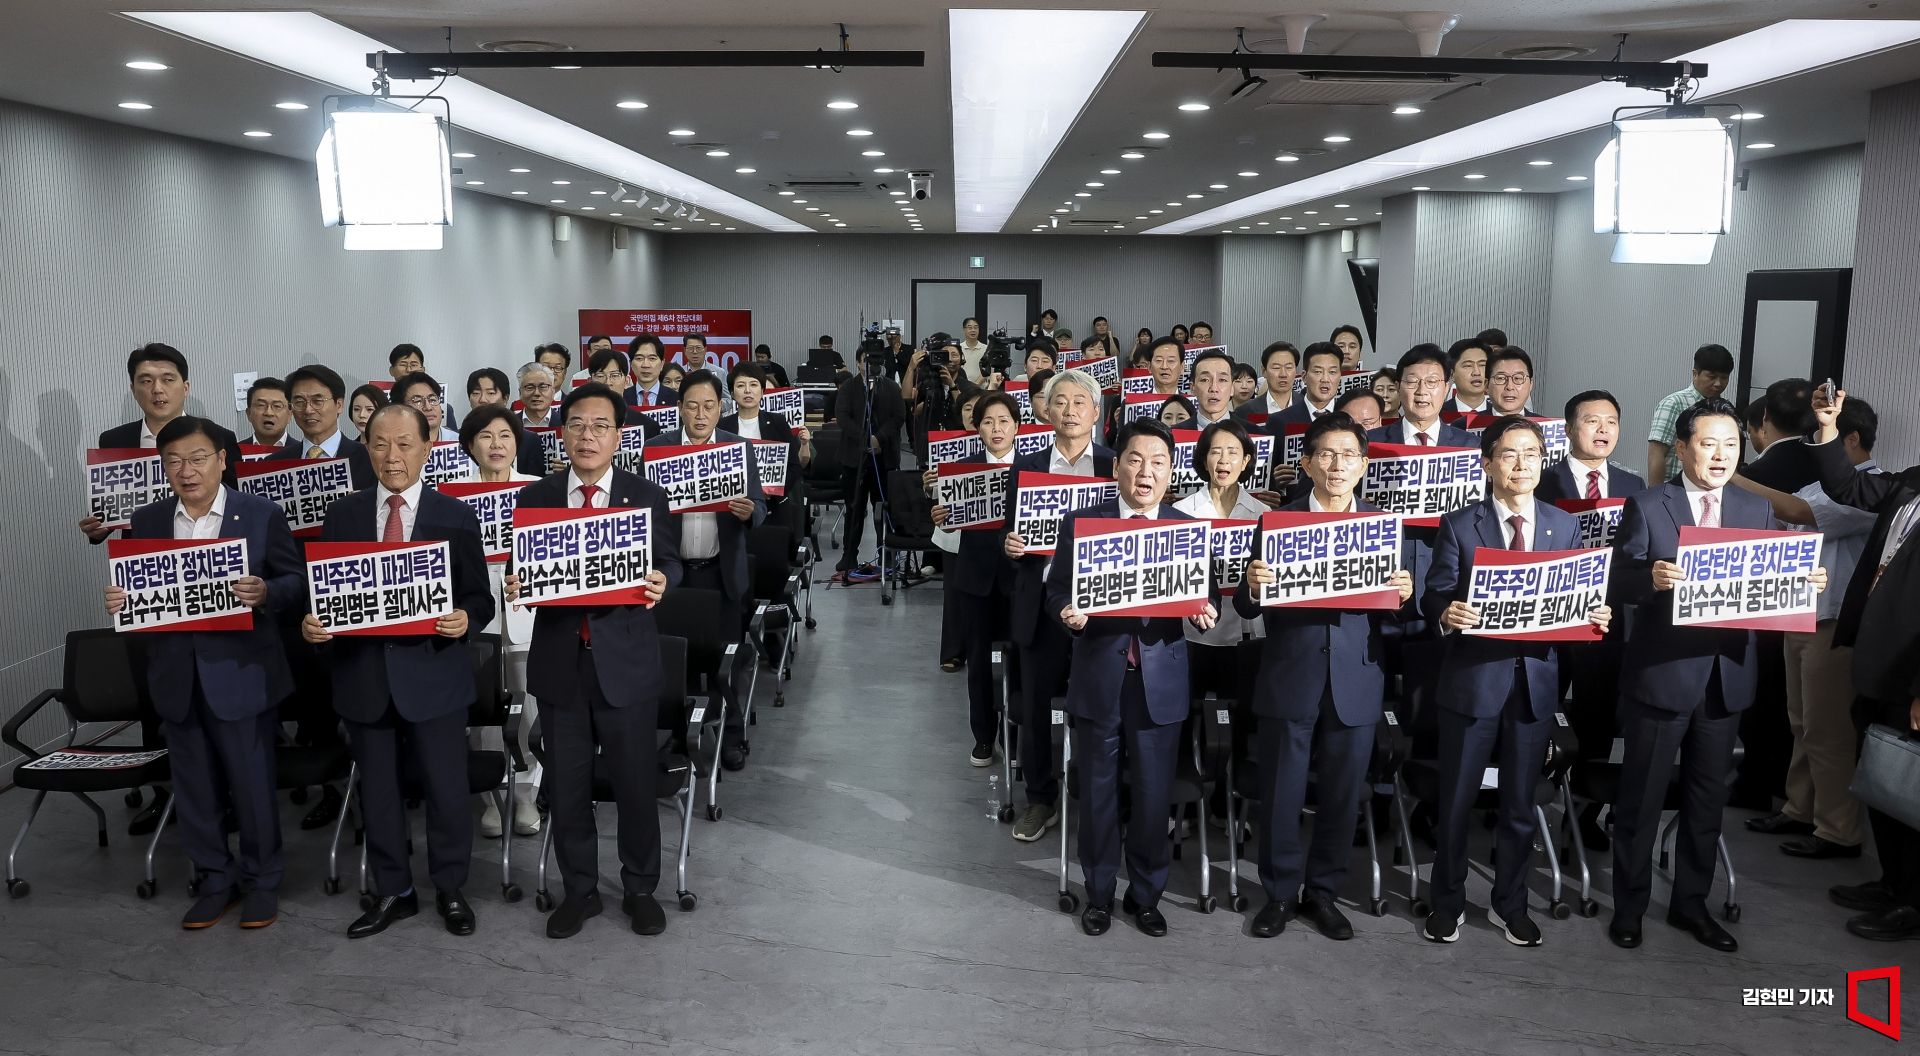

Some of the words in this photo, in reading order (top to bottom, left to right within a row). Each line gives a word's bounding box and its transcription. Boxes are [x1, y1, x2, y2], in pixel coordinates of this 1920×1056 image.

[657, 314, 675, 322] 제6차
[676, 314, 703, 322] 전당대회
[769, 391, 802, 413] 파괴특검
[91, 461, 148, 495] 민주주의
[296, 462, 348, 496] 정치보복
[697, 446, 744, 477] 정치보복
[1366, 458, 1423, 490] 민주주의
[1426, 453, 1484, 485] 파괴특검
[699, 471, 745, 502] 중단하라
[1020, 487, 1074, 518] 민주주의
[517, 522, 581, 563] 야당탄압
[584, 512, 648, 554] 정치보복
[1077, 534, 1139, 574] 민주주의
[1143, 526, 1207, 564] 파괴특검
[1266, 527, 1330, 565] 야당탄압
[1333, 517, 1397, 557] 정치보복
[115, 553, 178, 592] 야당탄압
[181, 543, 244, 583] 정치보복
[312, 556, 377, 595] 민주주의
[381, 546, 446, 587] 파괴특검
[518, 557, 581, 599] 압수수색
[585, 548, 649, 588] 중단하라
[1332, 553, 1397, 591] 중단하라
[1473, 568, 1544, 600] 민주주의
[1543, 549, 1606, 593] 파괴특검
[1681, 547, 1748, 582] 야당탄압
[1749, 538, 1817, 576] 정치보복
[316, 590, 380, 627] 당원명부
[383, 581, 448, 620] 절대사수
[1077, 571, 1138, 609] 당원명부
[1142, 562, 1204, 600] 절대사수
[1678, 579, 1743, 619] 압수수색
[1746, 576, 1813, 612] 중단하라
